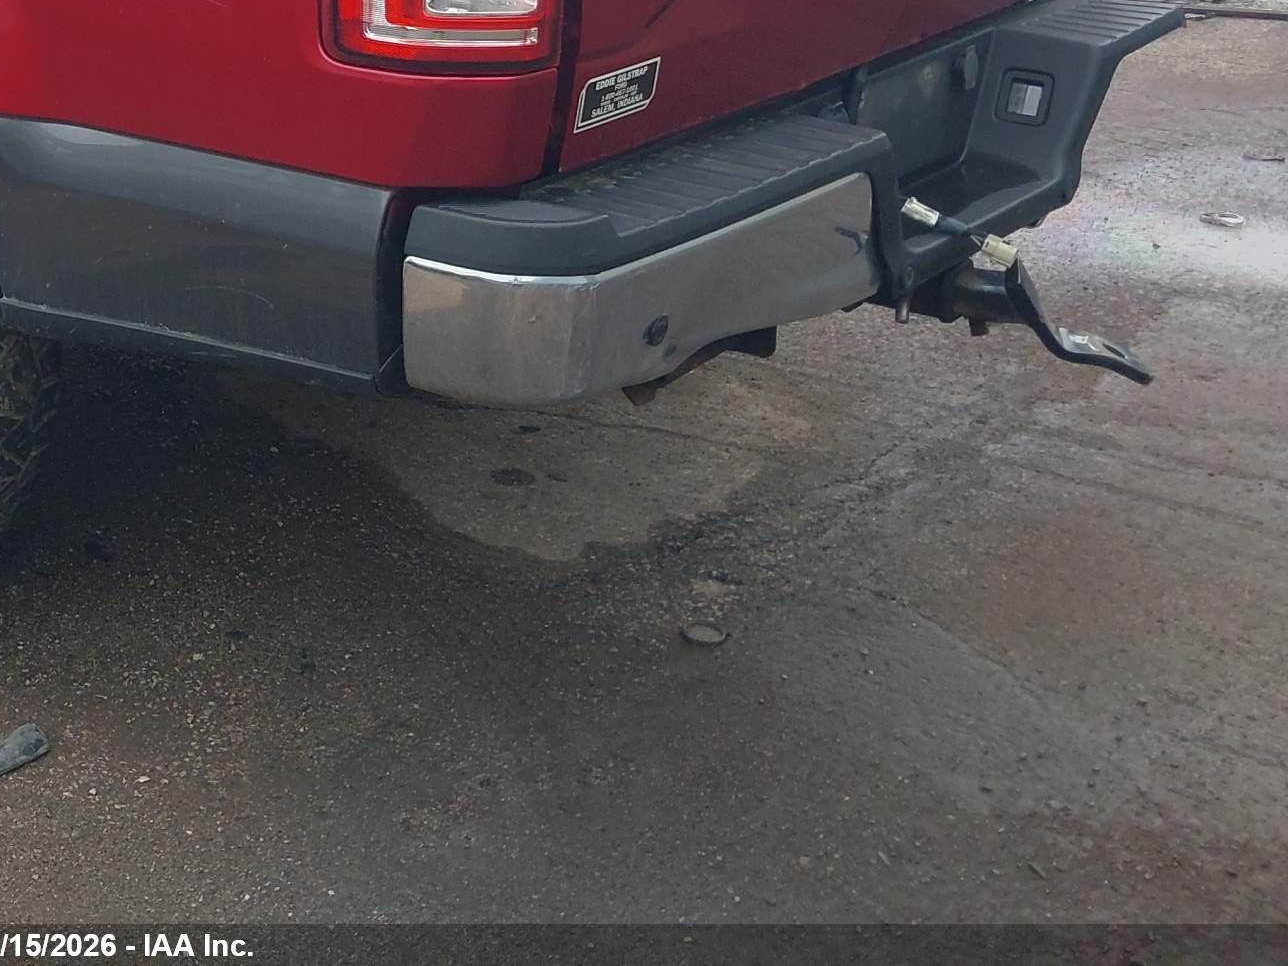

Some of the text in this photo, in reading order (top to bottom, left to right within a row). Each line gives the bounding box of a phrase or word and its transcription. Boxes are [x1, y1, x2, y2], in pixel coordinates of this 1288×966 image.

[596, 66, 648, 90] EDDIE GILSTRAP
[617, 93, 643, 109] INDIANA
